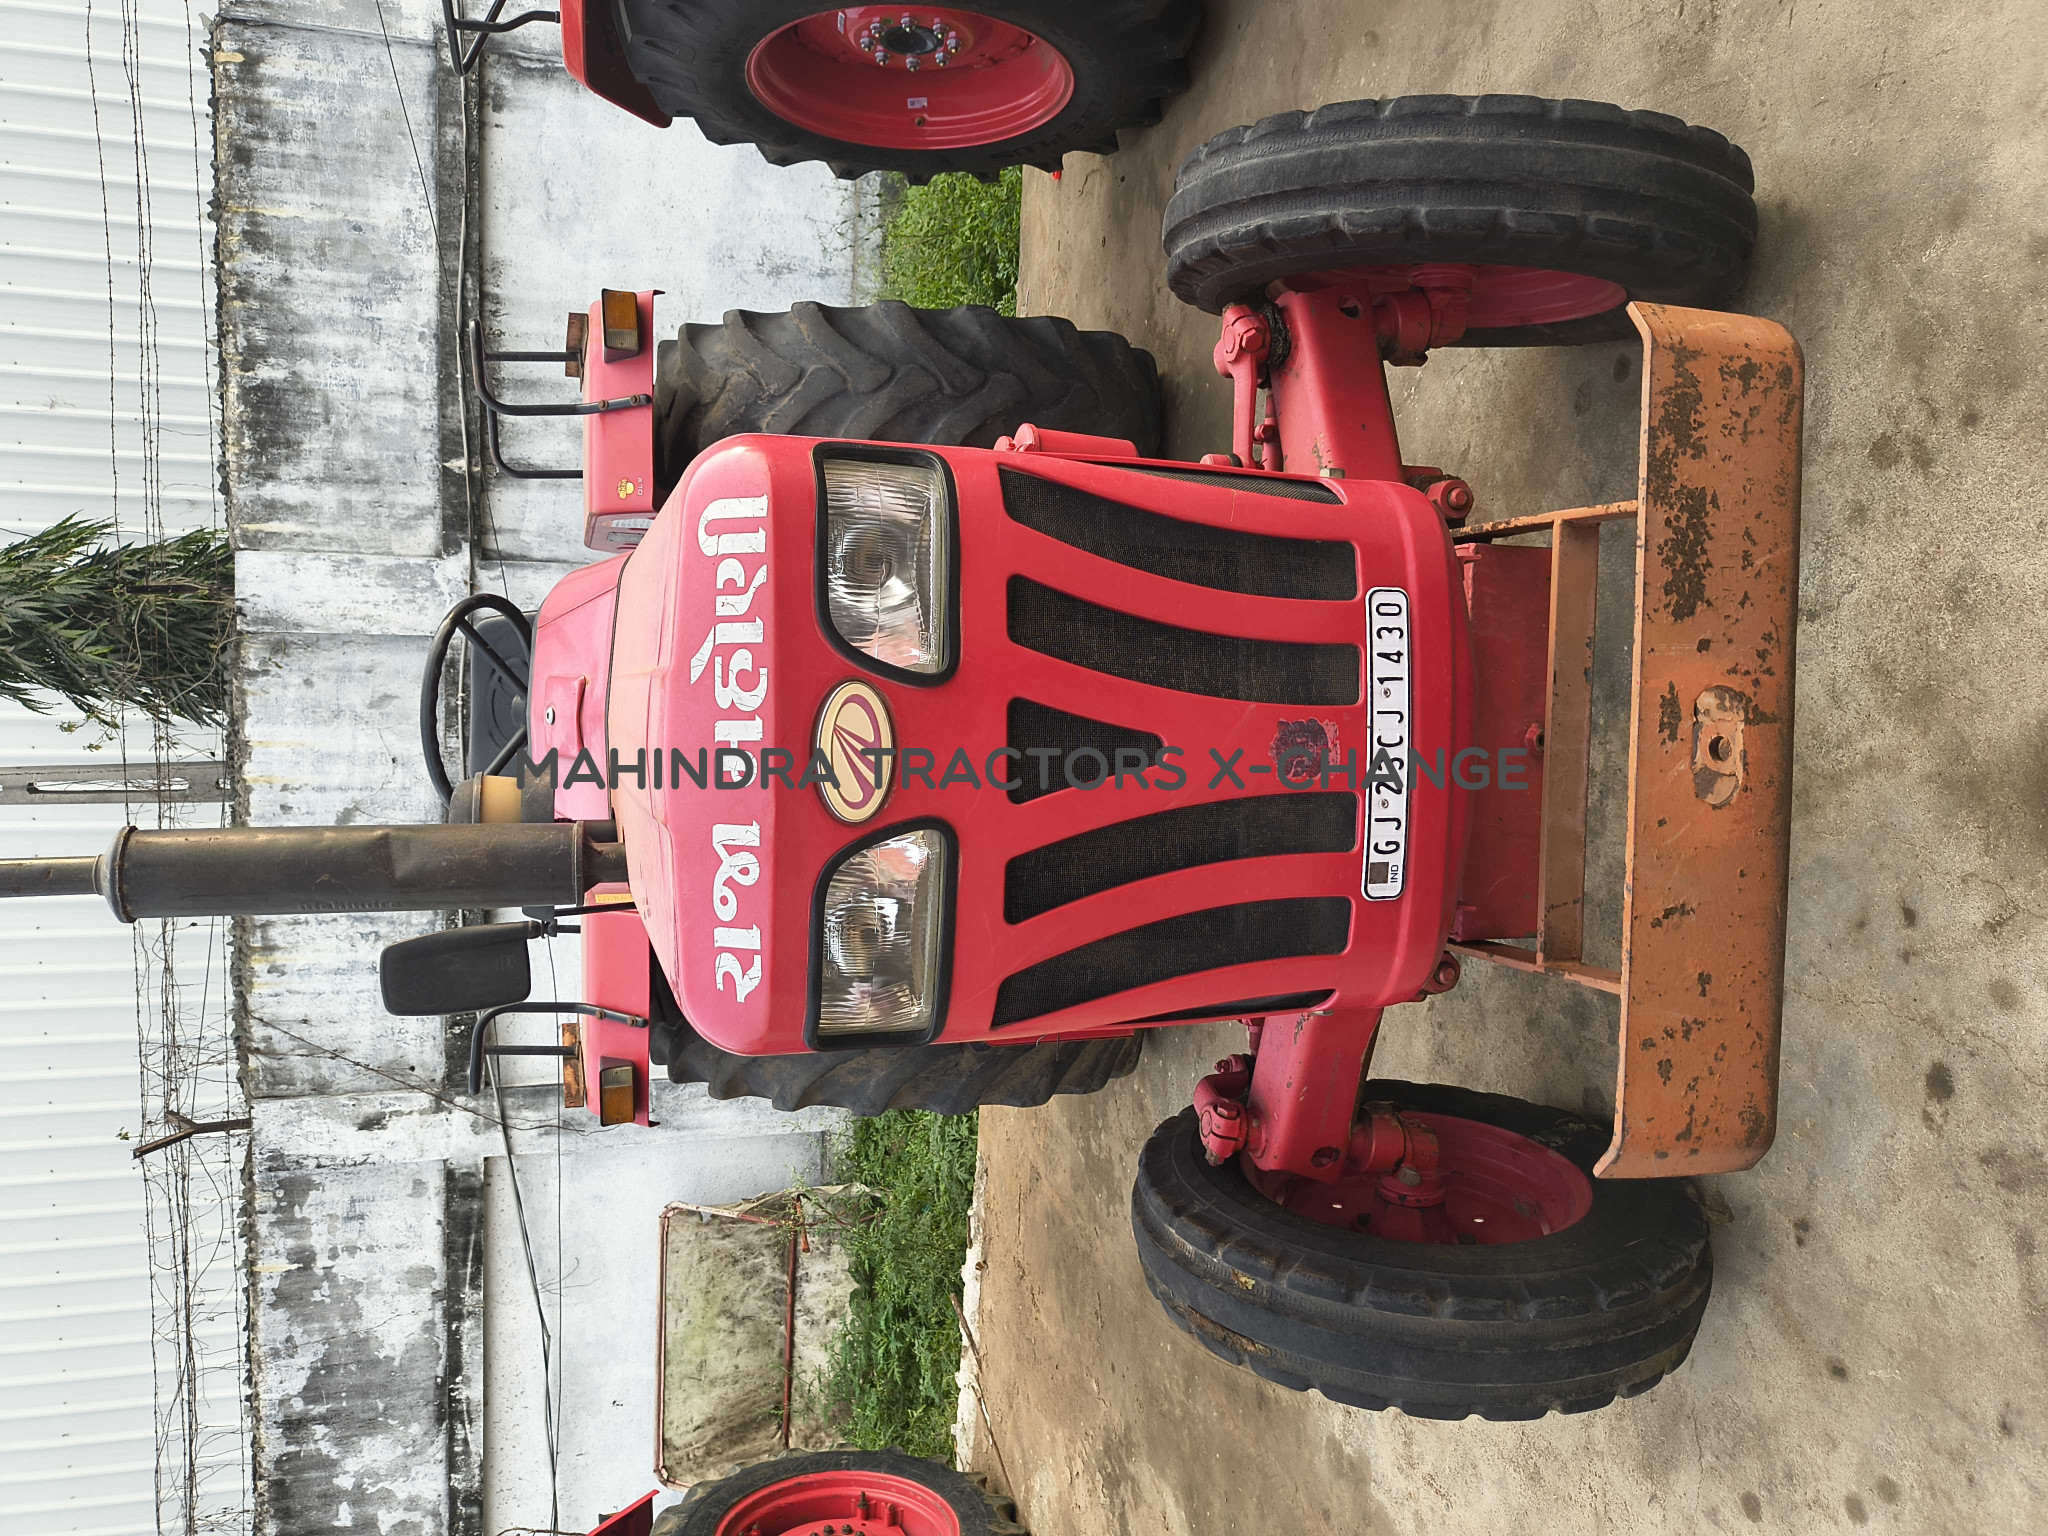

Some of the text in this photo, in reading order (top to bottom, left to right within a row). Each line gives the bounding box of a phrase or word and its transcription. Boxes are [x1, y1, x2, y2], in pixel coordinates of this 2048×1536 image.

[1376, 602, 1404, 685] 1430
[712, 820, 762, 1003] રાજા
[1389, 864, 1399, 884] IND
